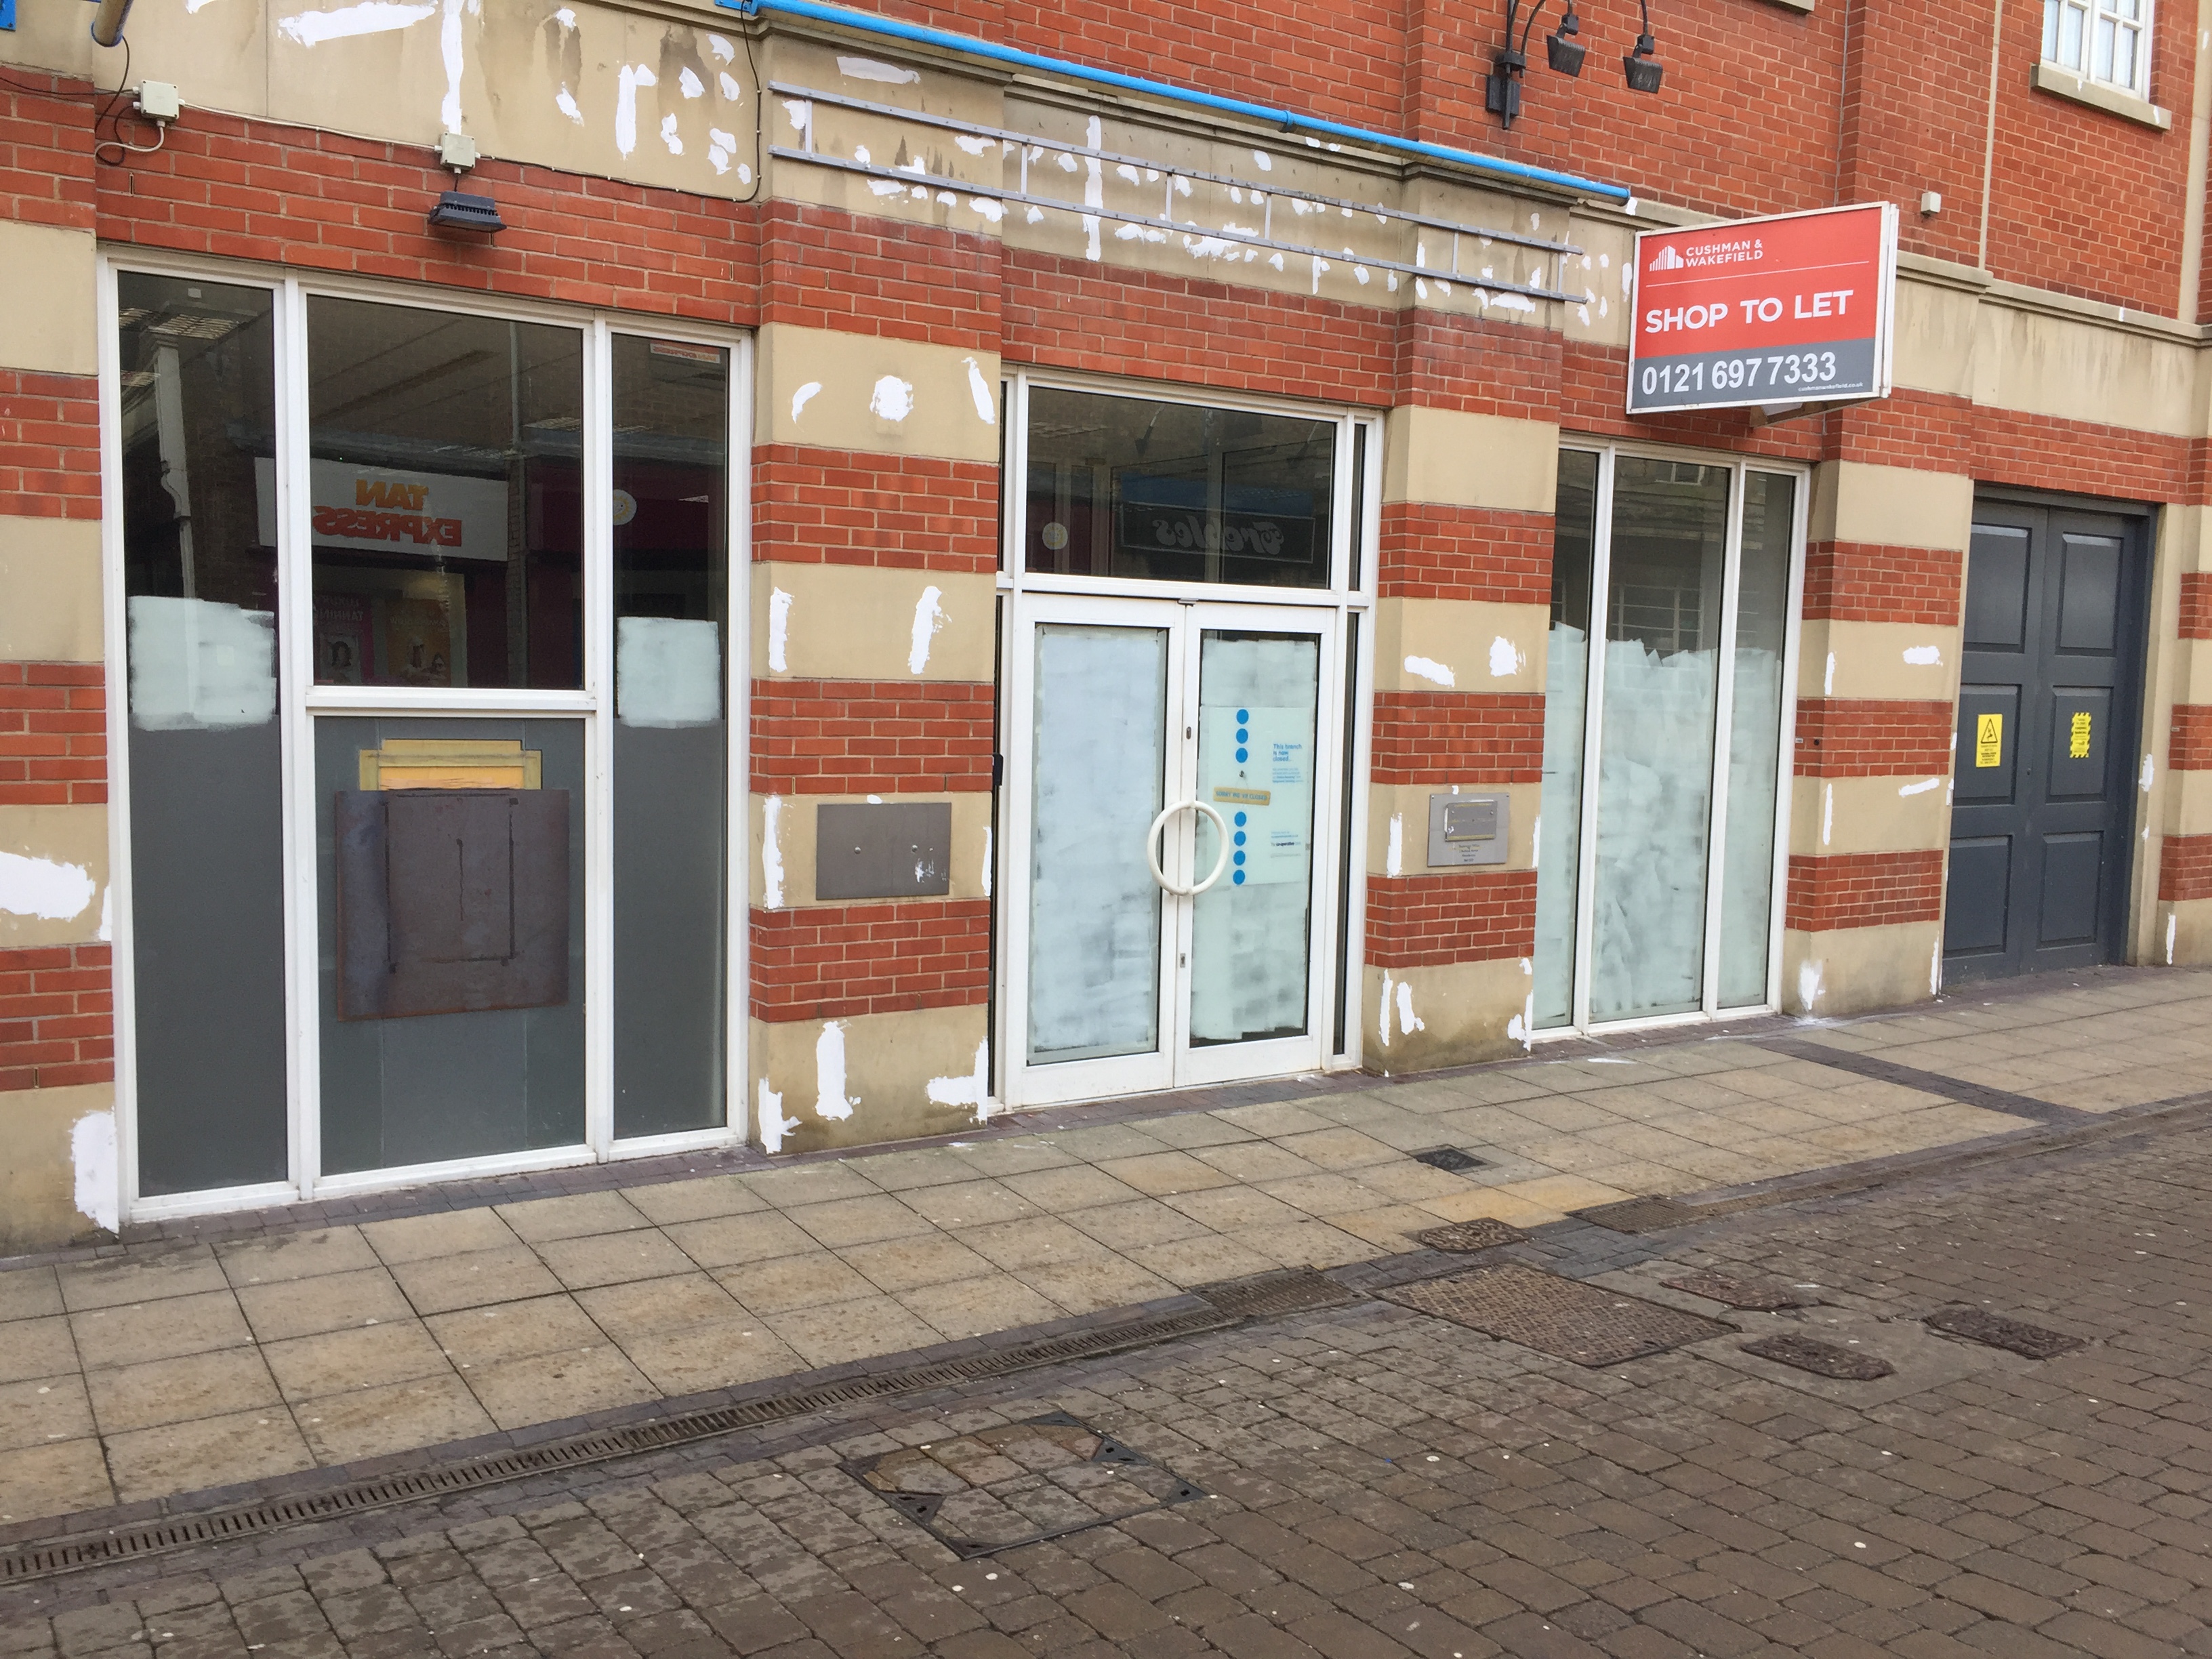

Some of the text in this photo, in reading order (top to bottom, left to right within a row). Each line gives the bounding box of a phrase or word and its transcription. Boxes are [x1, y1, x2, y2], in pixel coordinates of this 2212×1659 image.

[1685, 239, 1763, 257] CUSHMAN &
[1685, 249, 1763, 268] WAKEFIELD
[1645, 289, 1854, 333] SHOP TO LET
[1641, 351, 1837, 395] 0121 697 7333
[1797, 381, 1864, 392] cushmanwakefield.co.uk
